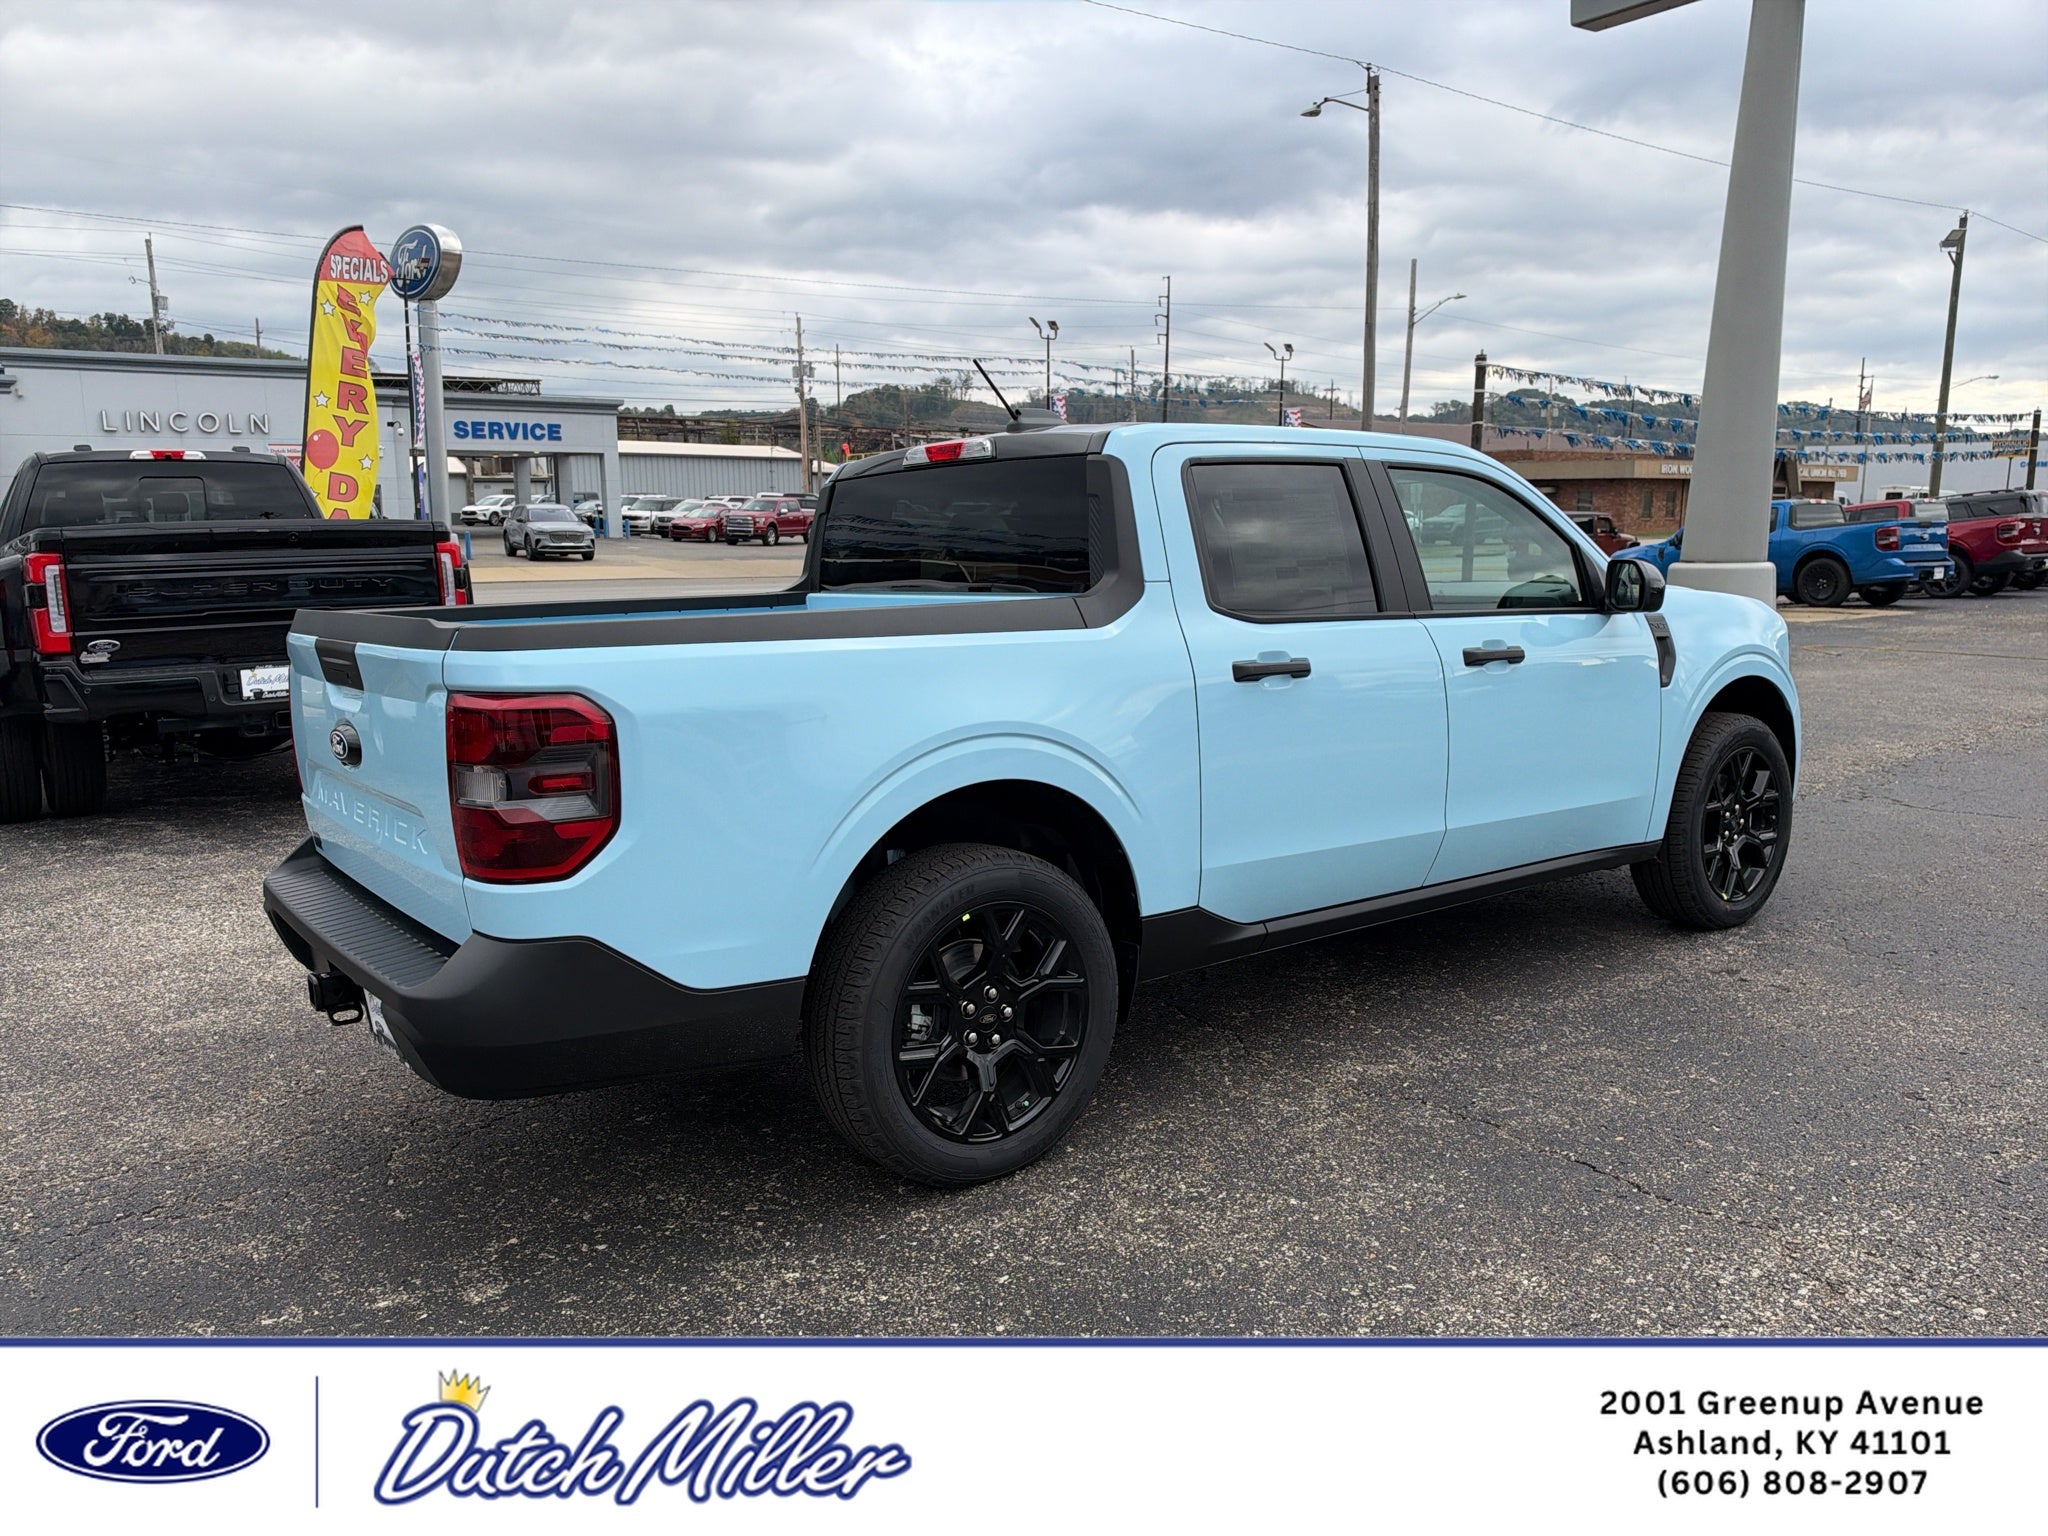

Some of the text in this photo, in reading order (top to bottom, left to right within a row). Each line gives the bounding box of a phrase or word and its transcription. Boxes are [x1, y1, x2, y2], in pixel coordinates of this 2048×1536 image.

[329, 254, 389, 284] SPECIALS
[100, 410, 271, 435] LINCOLN
[453, 420, 563, 442] SERVICE
[1661, 464, 1678, 474] IRON
[288, 577, 393, 591] DUTY
[317, 779, 428, 855] MAVERICK
